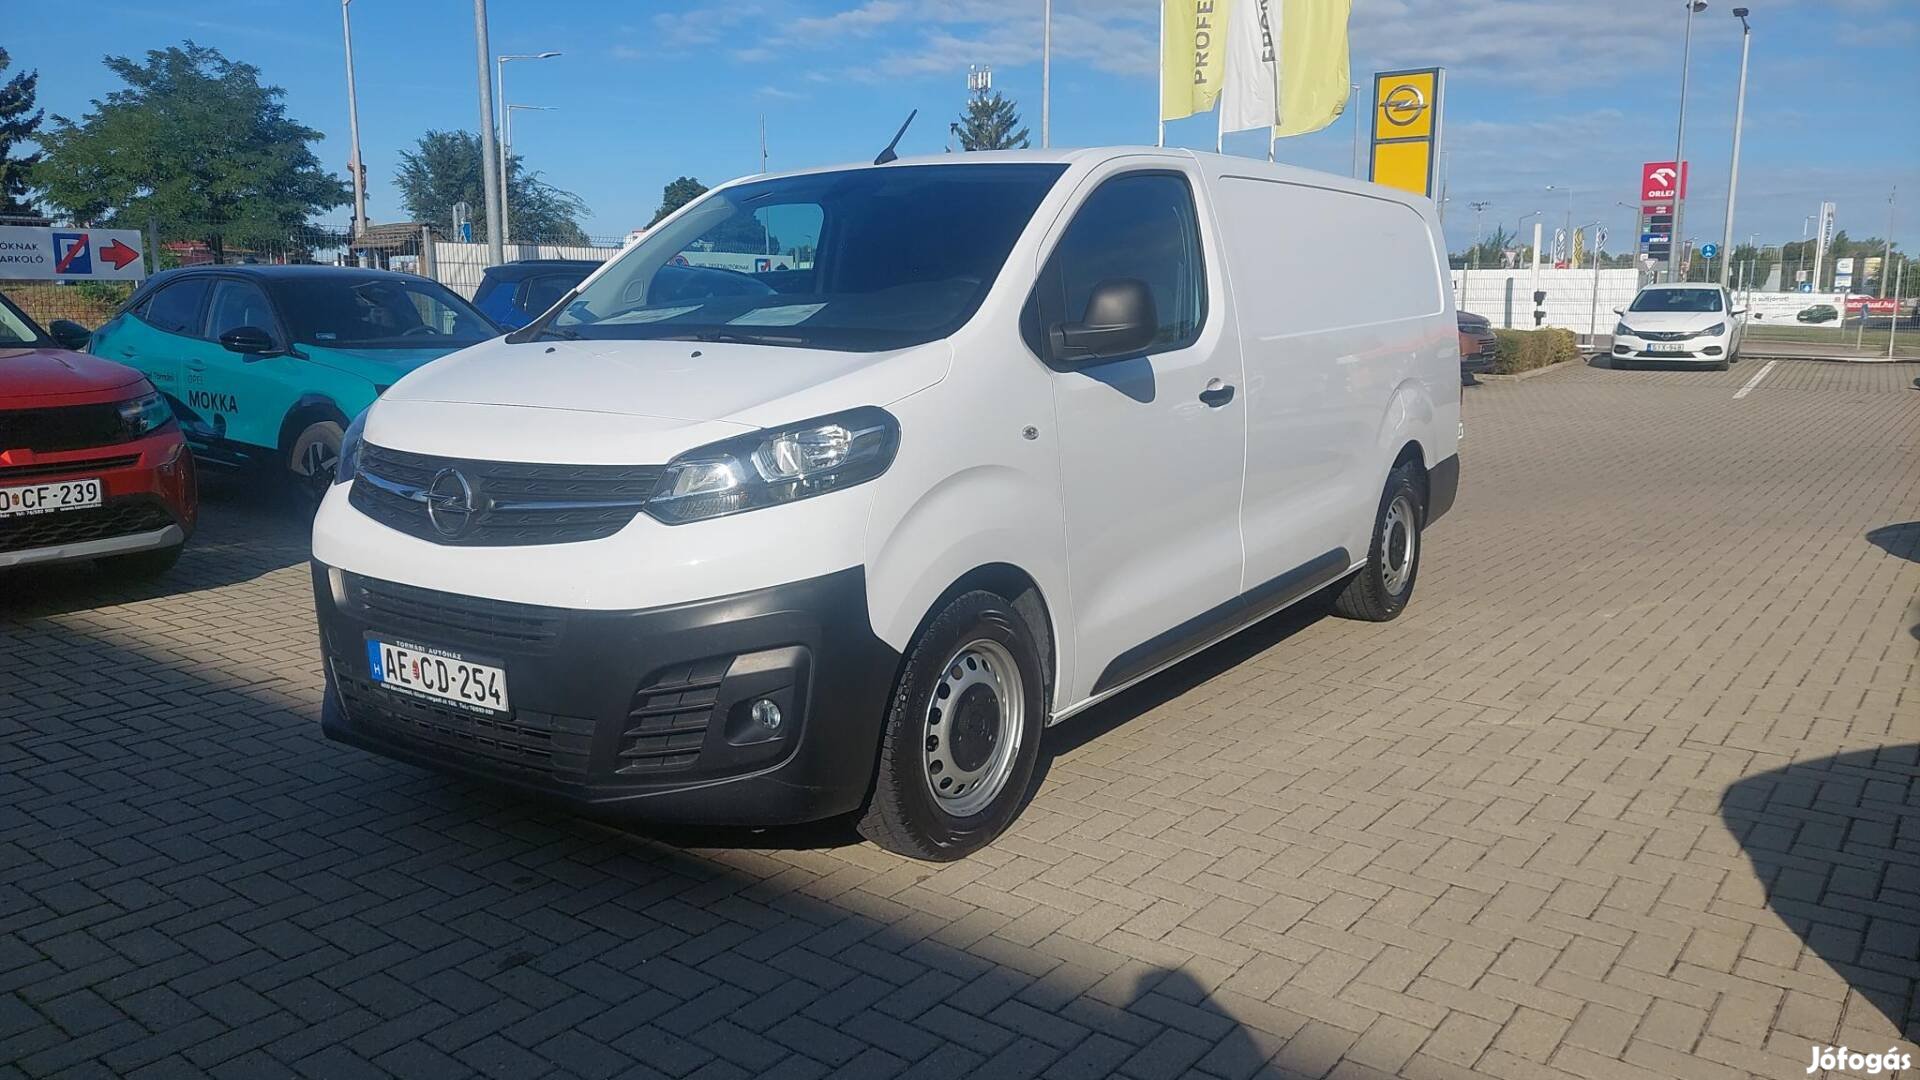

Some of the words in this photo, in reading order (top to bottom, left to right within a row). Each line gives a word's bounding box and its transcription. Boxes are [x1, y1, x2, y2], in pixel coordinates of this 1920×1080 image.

[1194, 0, 1214, 84] PROFE
[188, 390, 238, 414] MOKKA
[22, 482, 97, 508] CF-239
